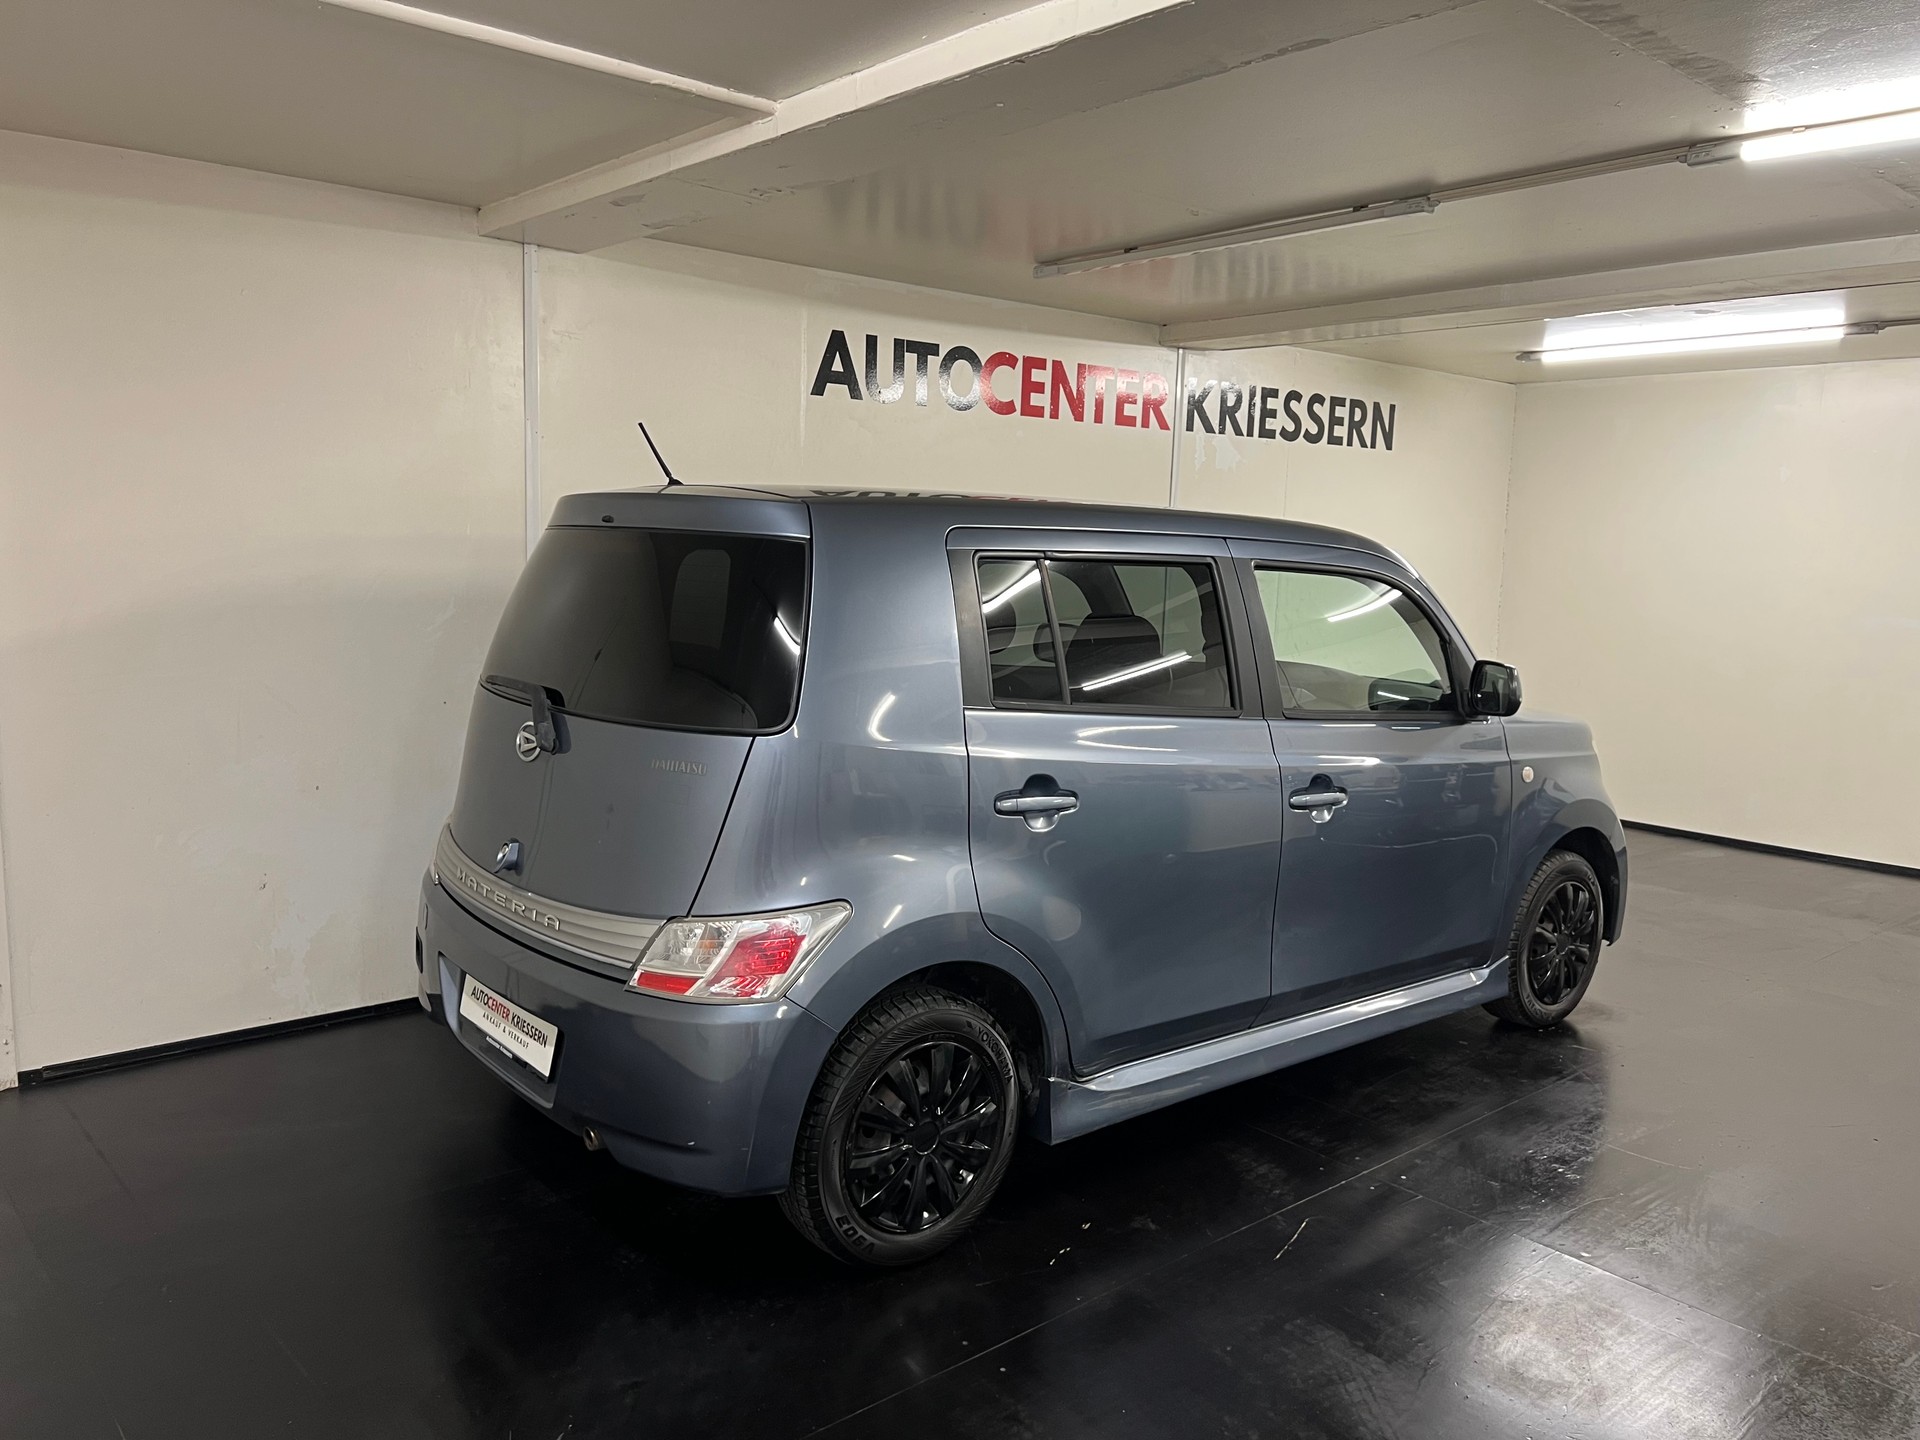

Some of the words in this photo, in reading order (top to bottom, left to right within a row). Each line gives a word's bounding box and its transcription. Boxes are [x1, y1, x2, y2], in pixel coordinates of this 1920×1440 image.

[810, 329, 1171, 431] AUTOCENTER
[1185, 376, 1397, 452] KRIESSERN
[456, 867, 561, 931] MATERIA
[470, 985, 511, 1022] AUTOCENTER
[510, 1011, 549, 1049] KRIESSERN
[482, 1012, 501, 1028] ANKAUF
[507, 1029, 530, 1050] VERKAUF
[976, 1025, 1014, 1084] YOKOHAMA
